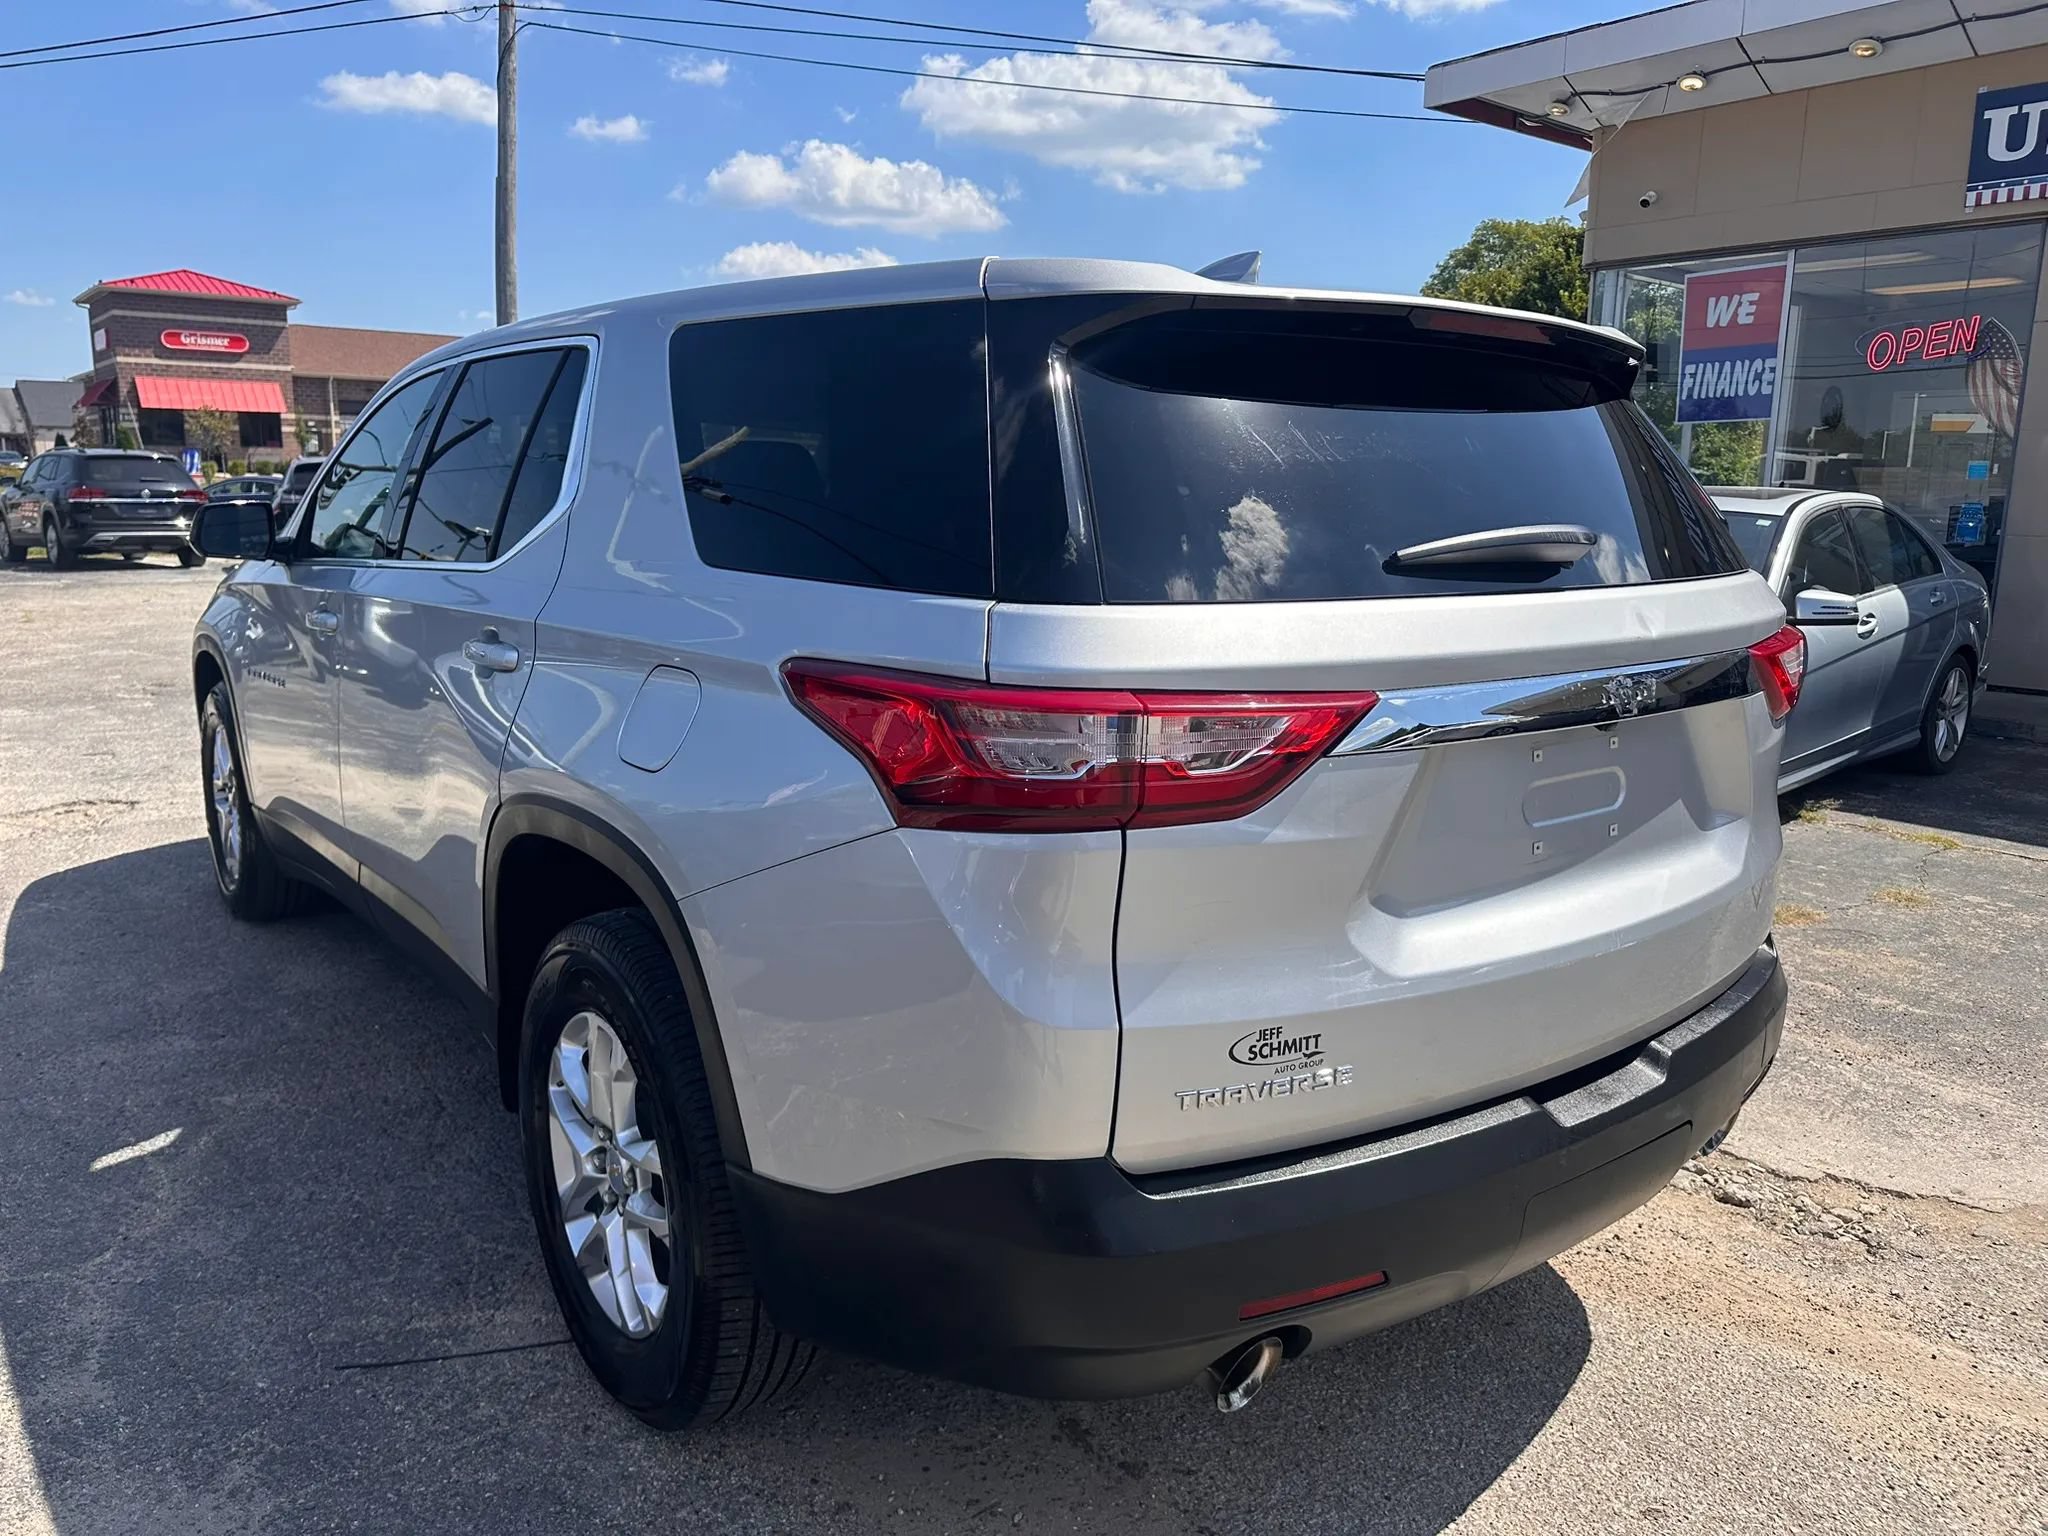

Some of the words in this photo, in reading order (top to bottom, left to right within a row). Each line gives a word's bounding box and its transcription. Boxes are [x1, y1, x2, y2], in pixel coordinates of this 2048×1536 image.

[1983, 100, 2048, 162] U
[1706, 292, 1760, 328] WE
[181, 332, 230, 346] Grismer
[1867, 315, 1980, 371] OPEN
[1681, 358, 1777, 401] FINANCE
[1247, 1034, 1322, 1061] SCHMITT
[1255, 1026, 1283, 1043] JEFF
[1274, 1064, 1296, 1075] AUTO
[1298, 1058, 1325, 1070] GROUP
[1175, 1064, 1353, 1111] TRAVERSE
